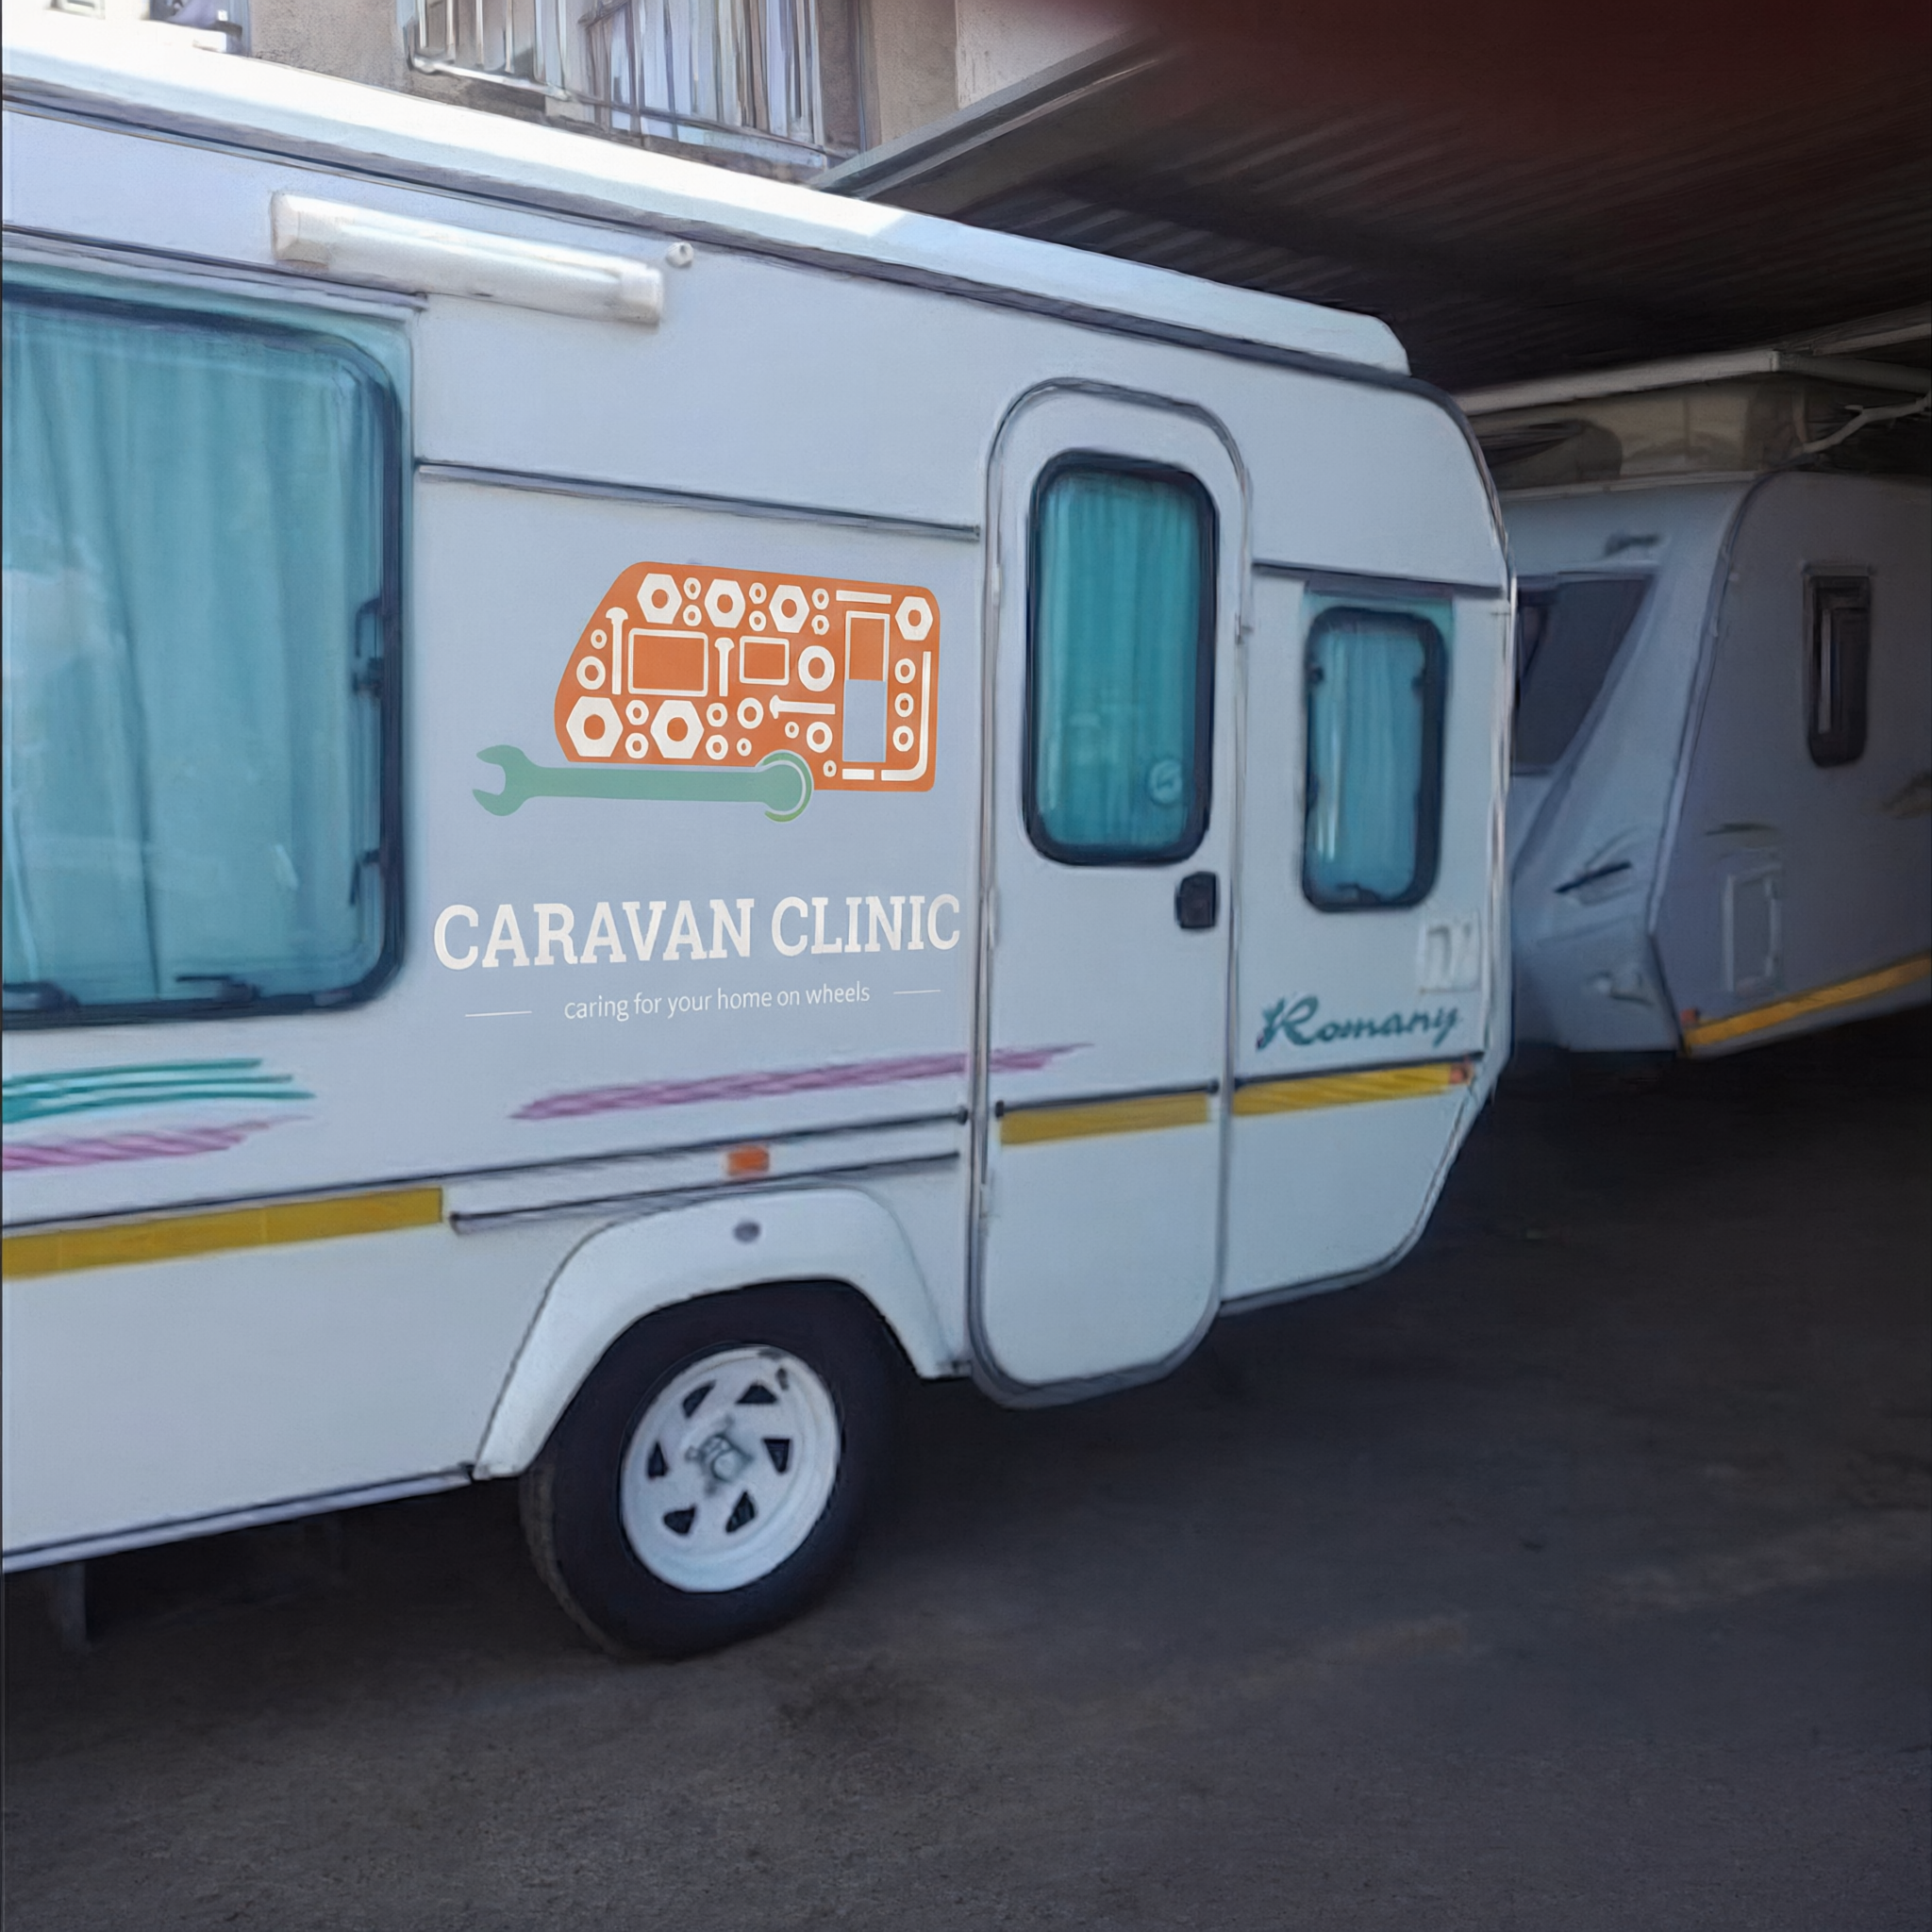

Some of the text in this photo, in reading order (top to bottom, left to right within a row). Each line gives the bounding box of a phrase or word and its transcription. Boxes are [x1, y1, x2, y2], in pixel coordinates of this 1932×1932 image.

[433, 893, 960, 971] CARAVAN CLINIC
[564, 980, 871, 1023] caring for your home on wheels
[1256, 995, 1459, 1051] Romany
